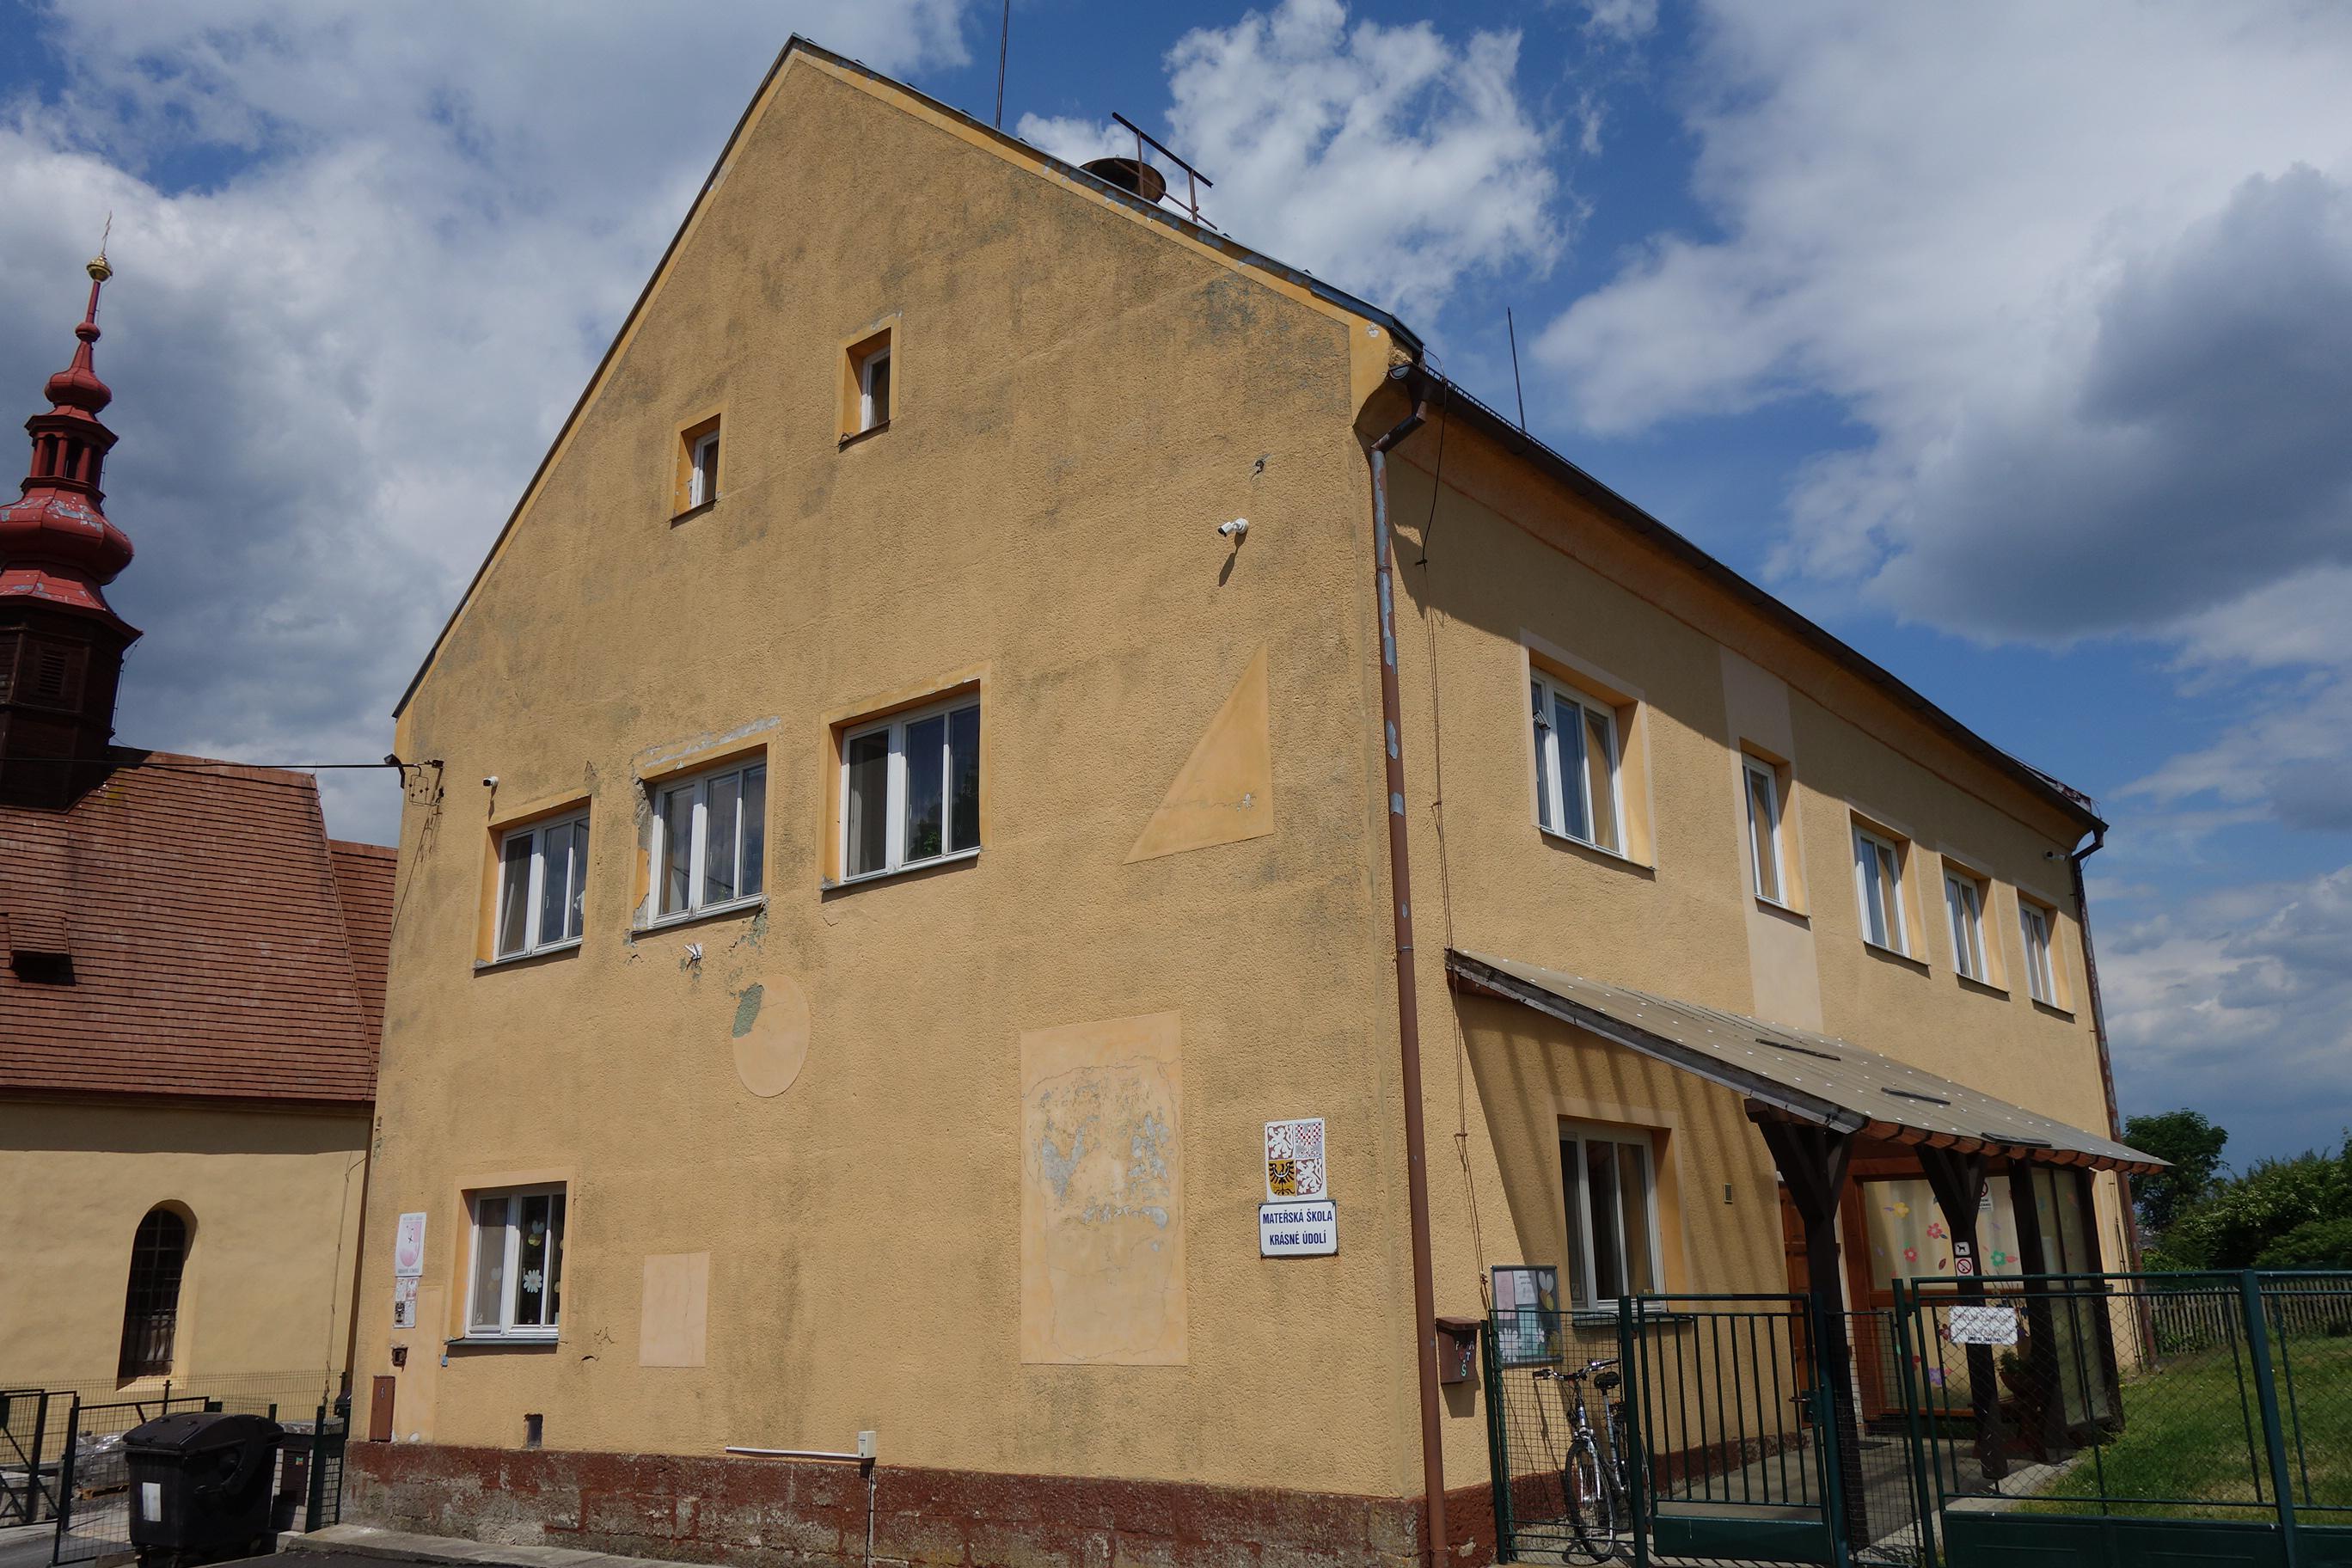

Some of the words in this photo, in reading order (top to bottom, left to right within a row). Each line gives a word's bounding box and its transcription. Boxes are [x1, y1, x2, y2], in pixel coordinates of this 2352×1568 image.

[1263, 1209, 1304, 1224] MATEŘSKÁ
[1306, 1208, 1333, 1222] ŠKOLA
[1269, 1230, 1300, 1246] KRÁSNÉ
[1302, 1229, 1326, 1245] ÚDOLÍ
